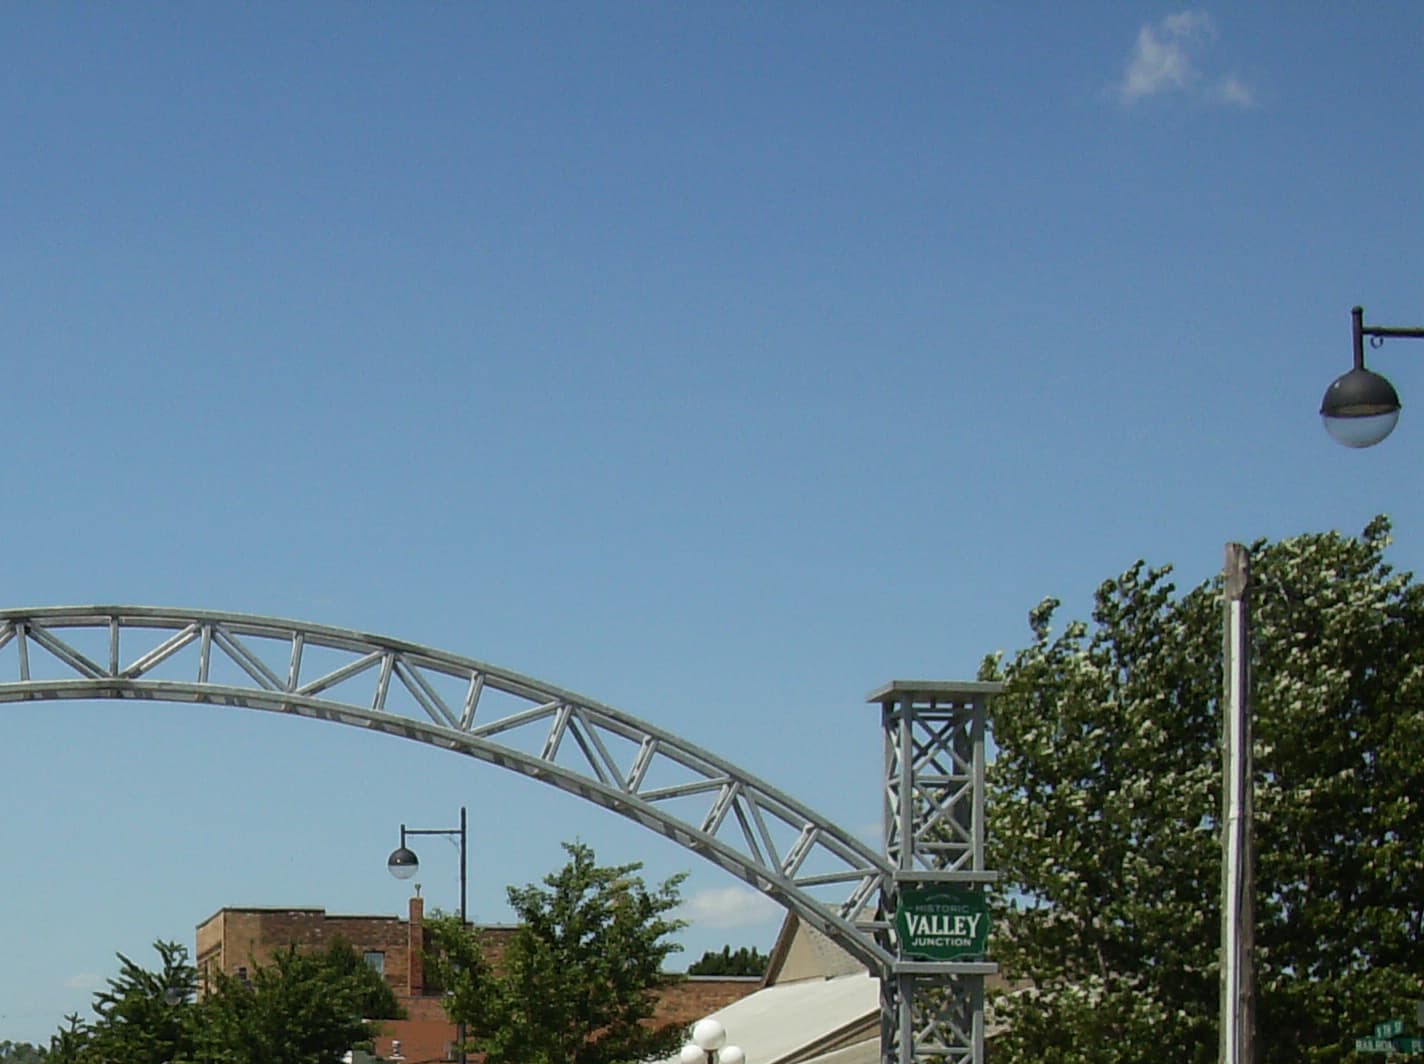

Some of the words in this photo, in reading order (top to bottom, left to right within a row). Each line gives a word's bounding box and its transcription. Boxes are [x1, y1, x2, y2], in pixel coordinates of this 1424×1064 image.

[915, 904, 970, 912] HISTORIC
[904, 911, 983, 938] VALLEY
[912, 938, 972, 946] JUNCTION
